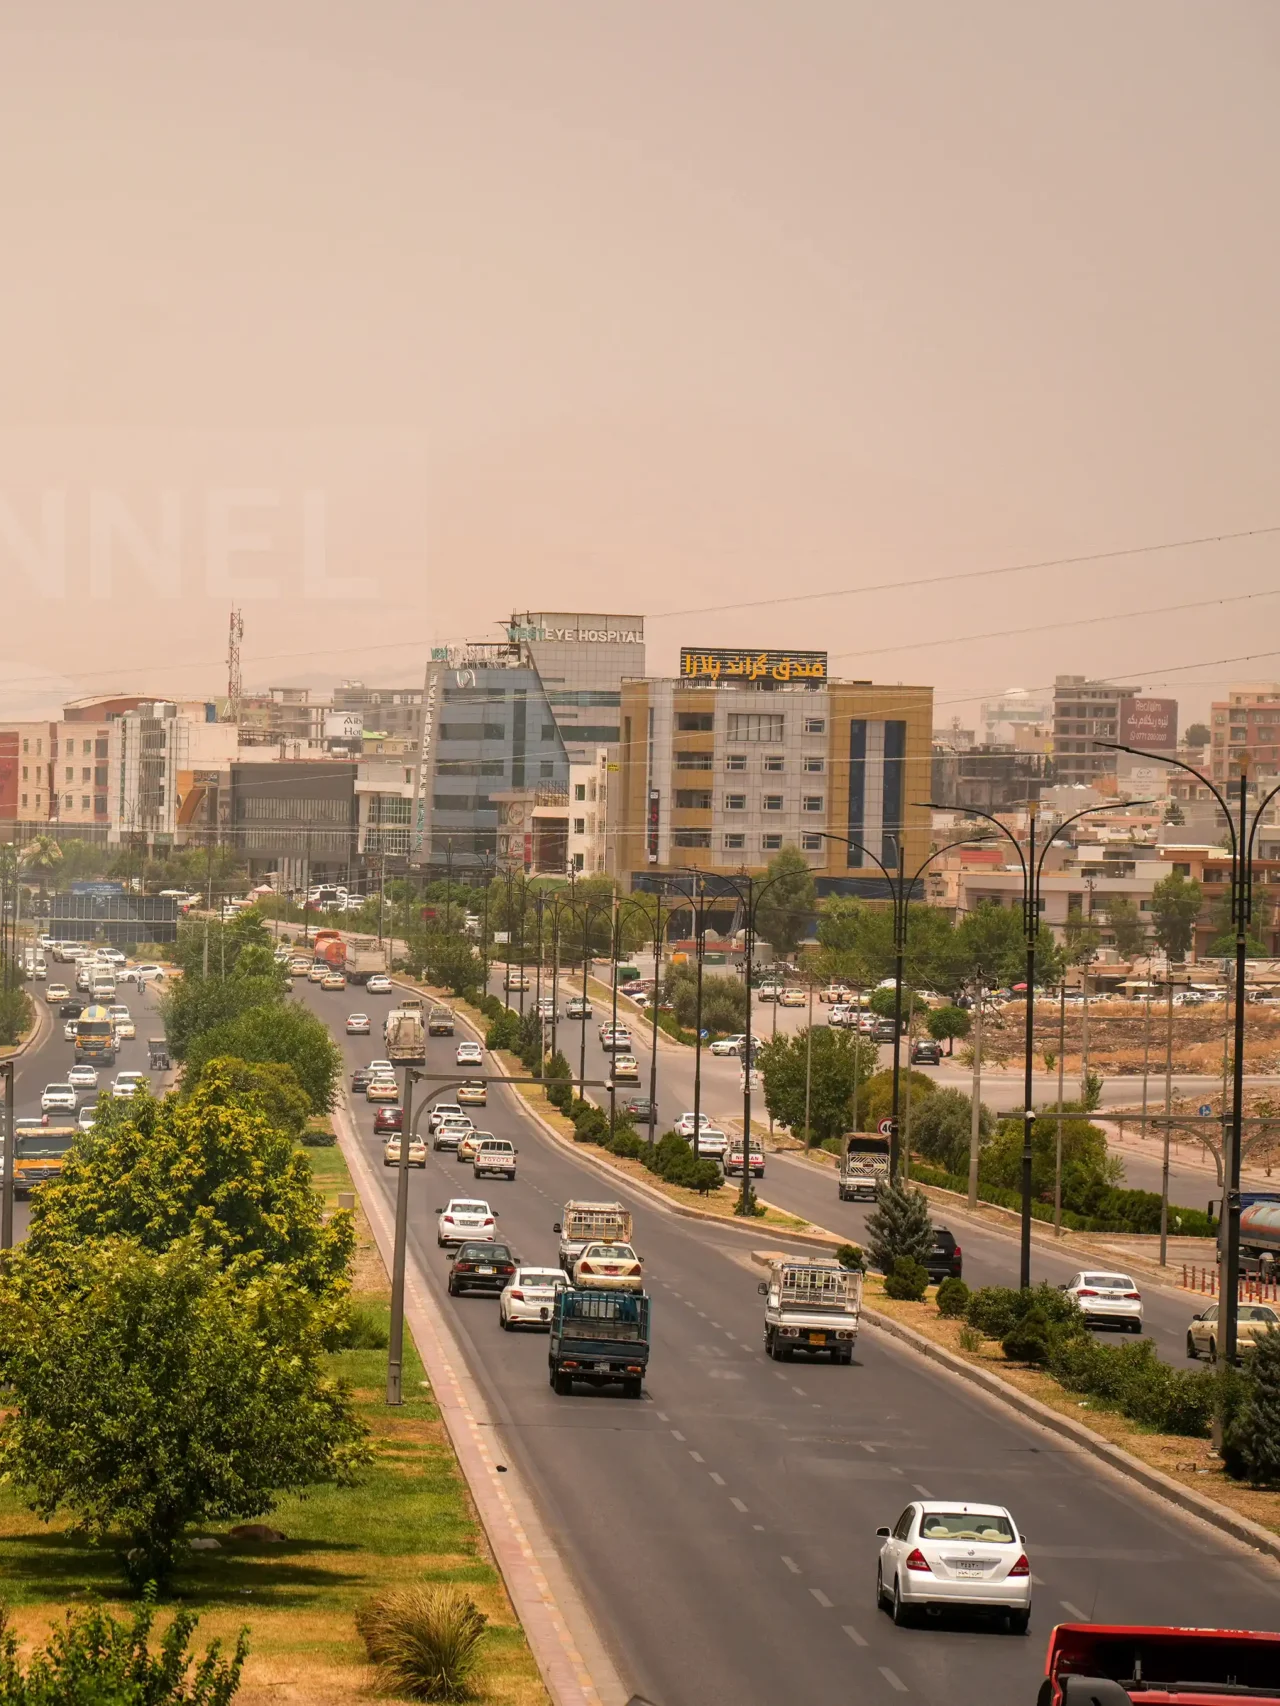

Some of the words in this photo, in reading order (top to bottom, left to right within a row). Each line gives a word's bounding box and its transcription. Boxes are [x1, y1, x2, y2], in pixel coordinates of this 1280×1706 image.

[545, 629, 573, 641] EYE
[579, 630, 644, 643] HOSPITAL
[772, 657, 824, 680] فندق
